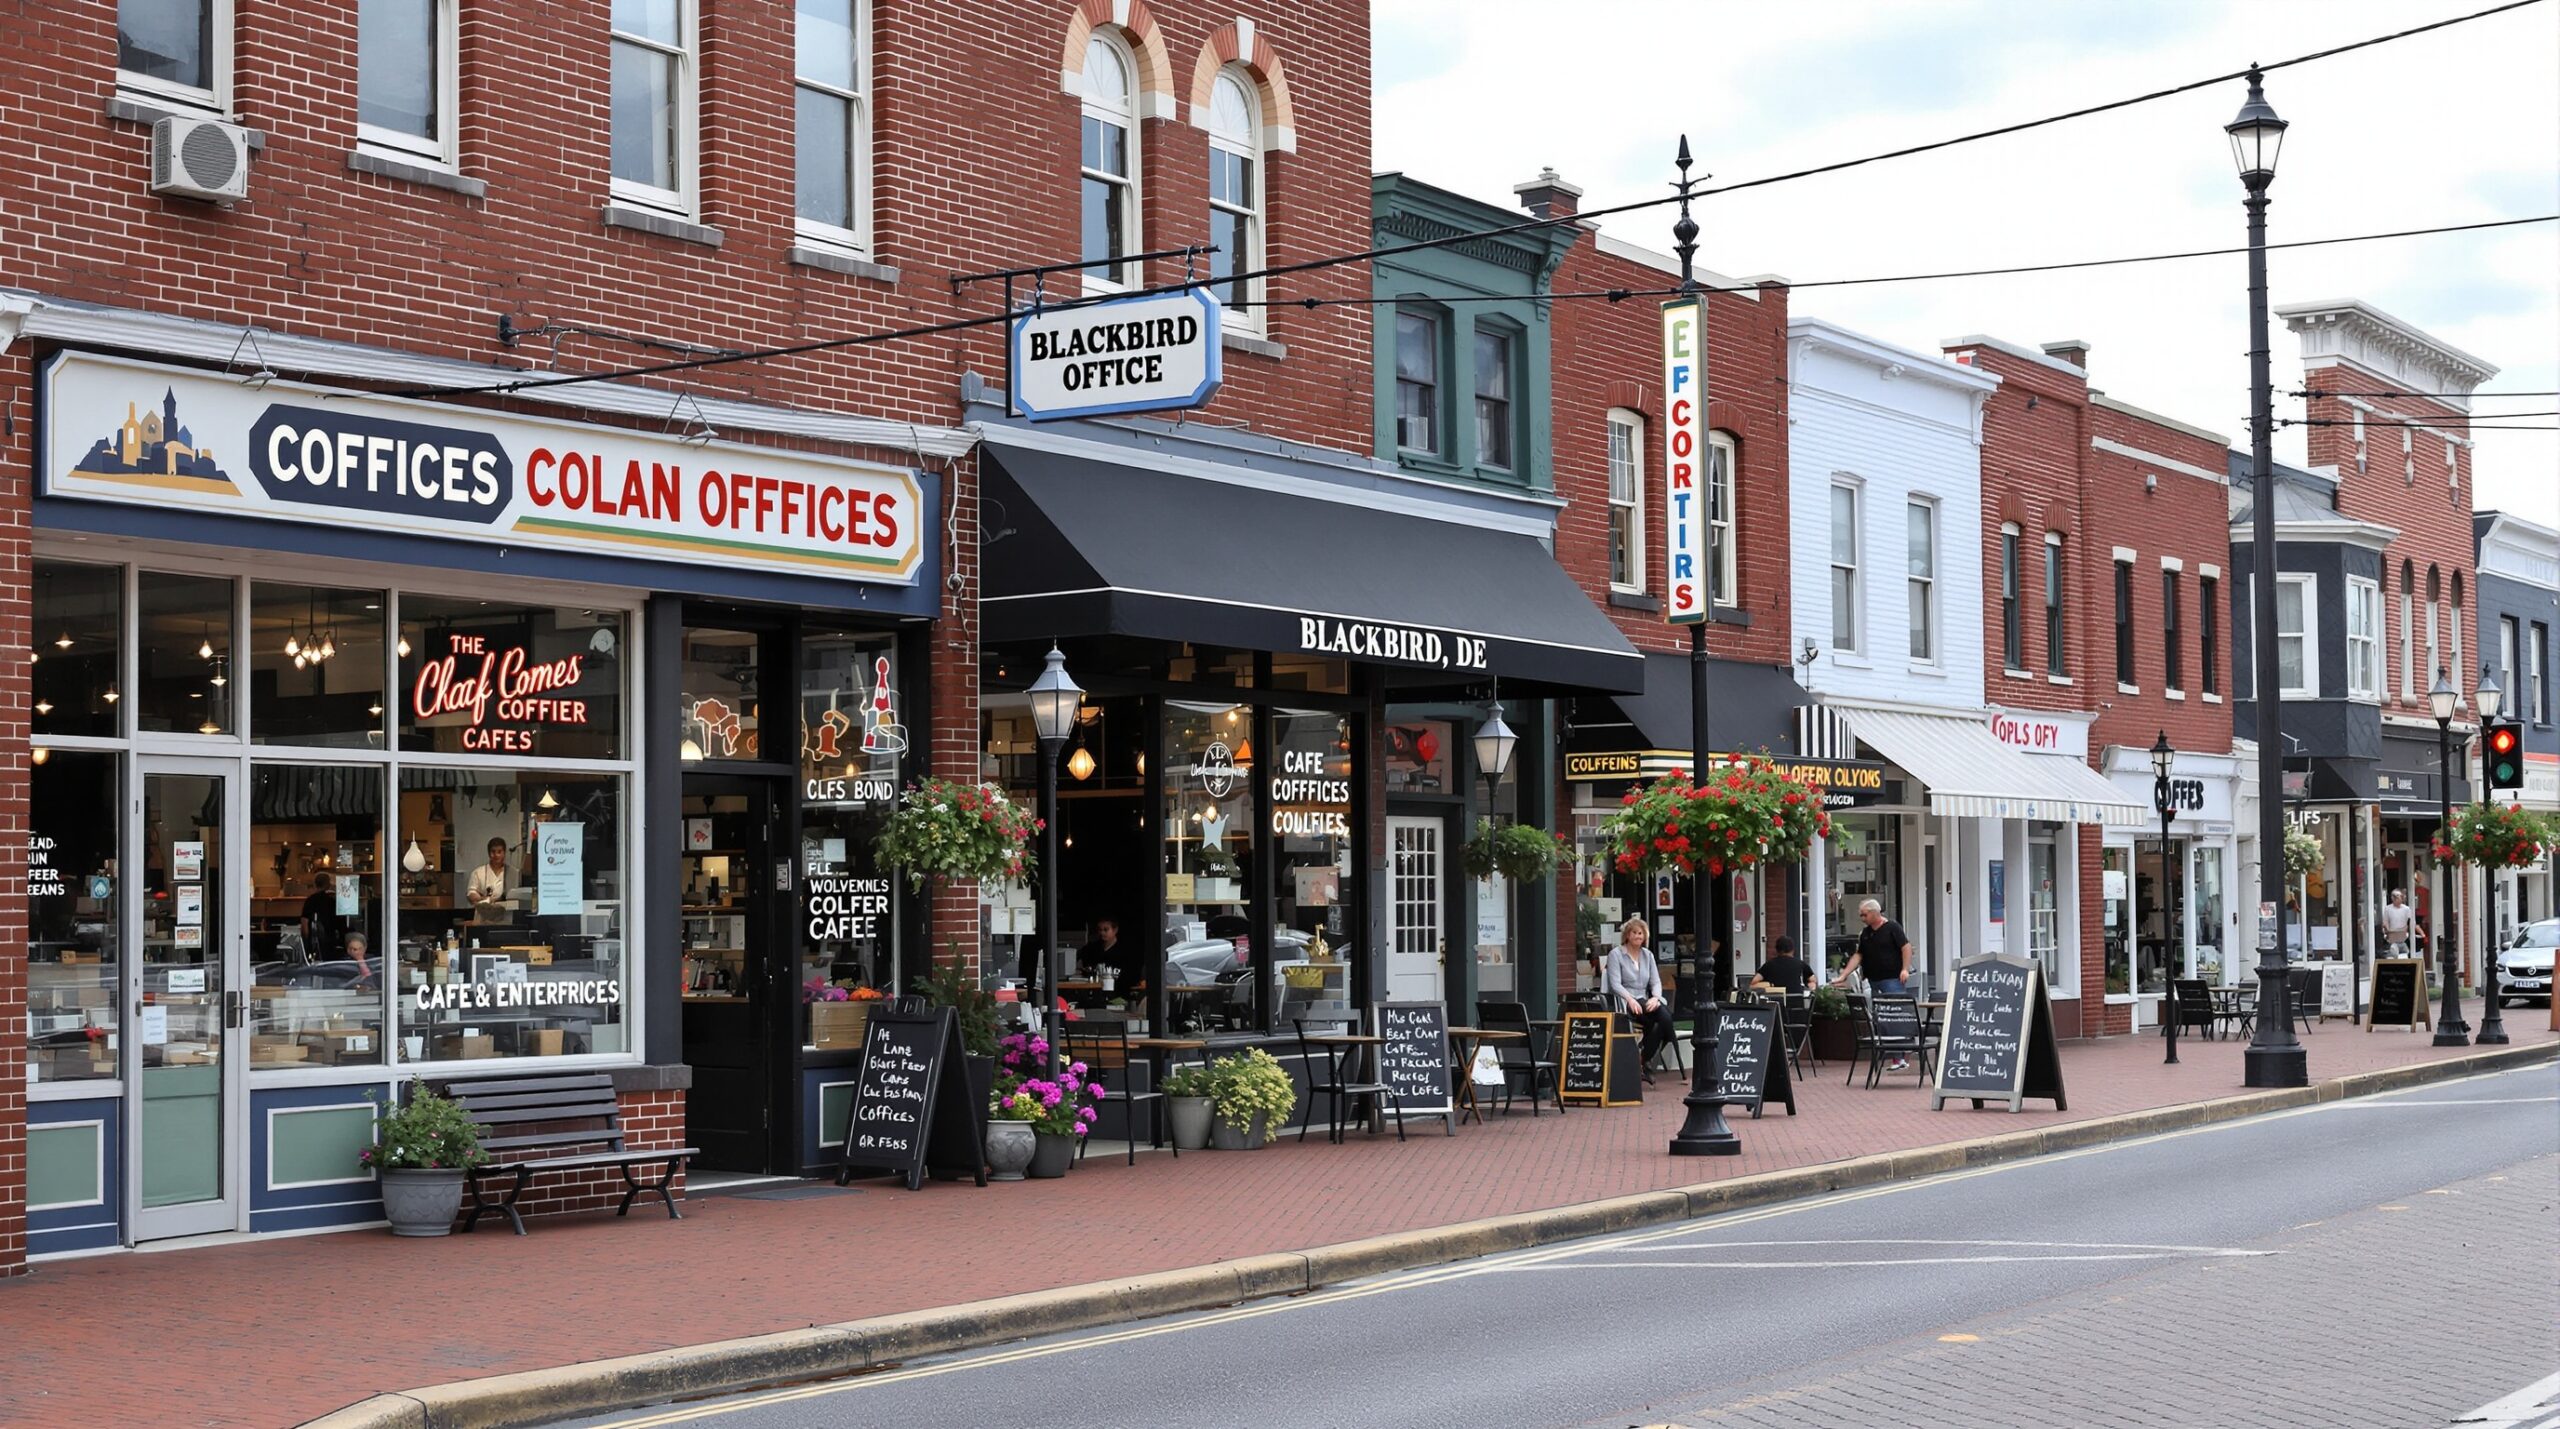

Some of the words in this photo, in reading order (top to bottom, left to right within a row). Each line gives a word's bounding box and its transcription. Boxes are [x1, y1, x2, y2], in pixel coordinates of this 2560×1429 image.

[1030, 315, 1198, 361] BLACKBIRD
[1063, 354, 1163, 391] OFFICE
[267, 424, 499, 505] COFFICES
[526, 447, 681, 523] COLAN
[699, 470, 898, 548] OFFFICES
[450, 634, 485, 655] THE
[1300, 616, 1449, 669] BLACKBIRD,
[1456, 636, 1488, 669] DE
[498, 699, 587, 723] COFFIER
[1284, 750, 1324, 774] CAFE
[854, 780, 893, 801] BOND
[1272, 778, 1350, 803] COFFFICES
[809, 895, 889, 915] COLFER
[809, 916, 877, 940] CAFEE
[416, 982, 473, 1010] CAFE
[475, 982, 491, 1008] &
[496, 980, 620, 1008] ENTERFRICES
